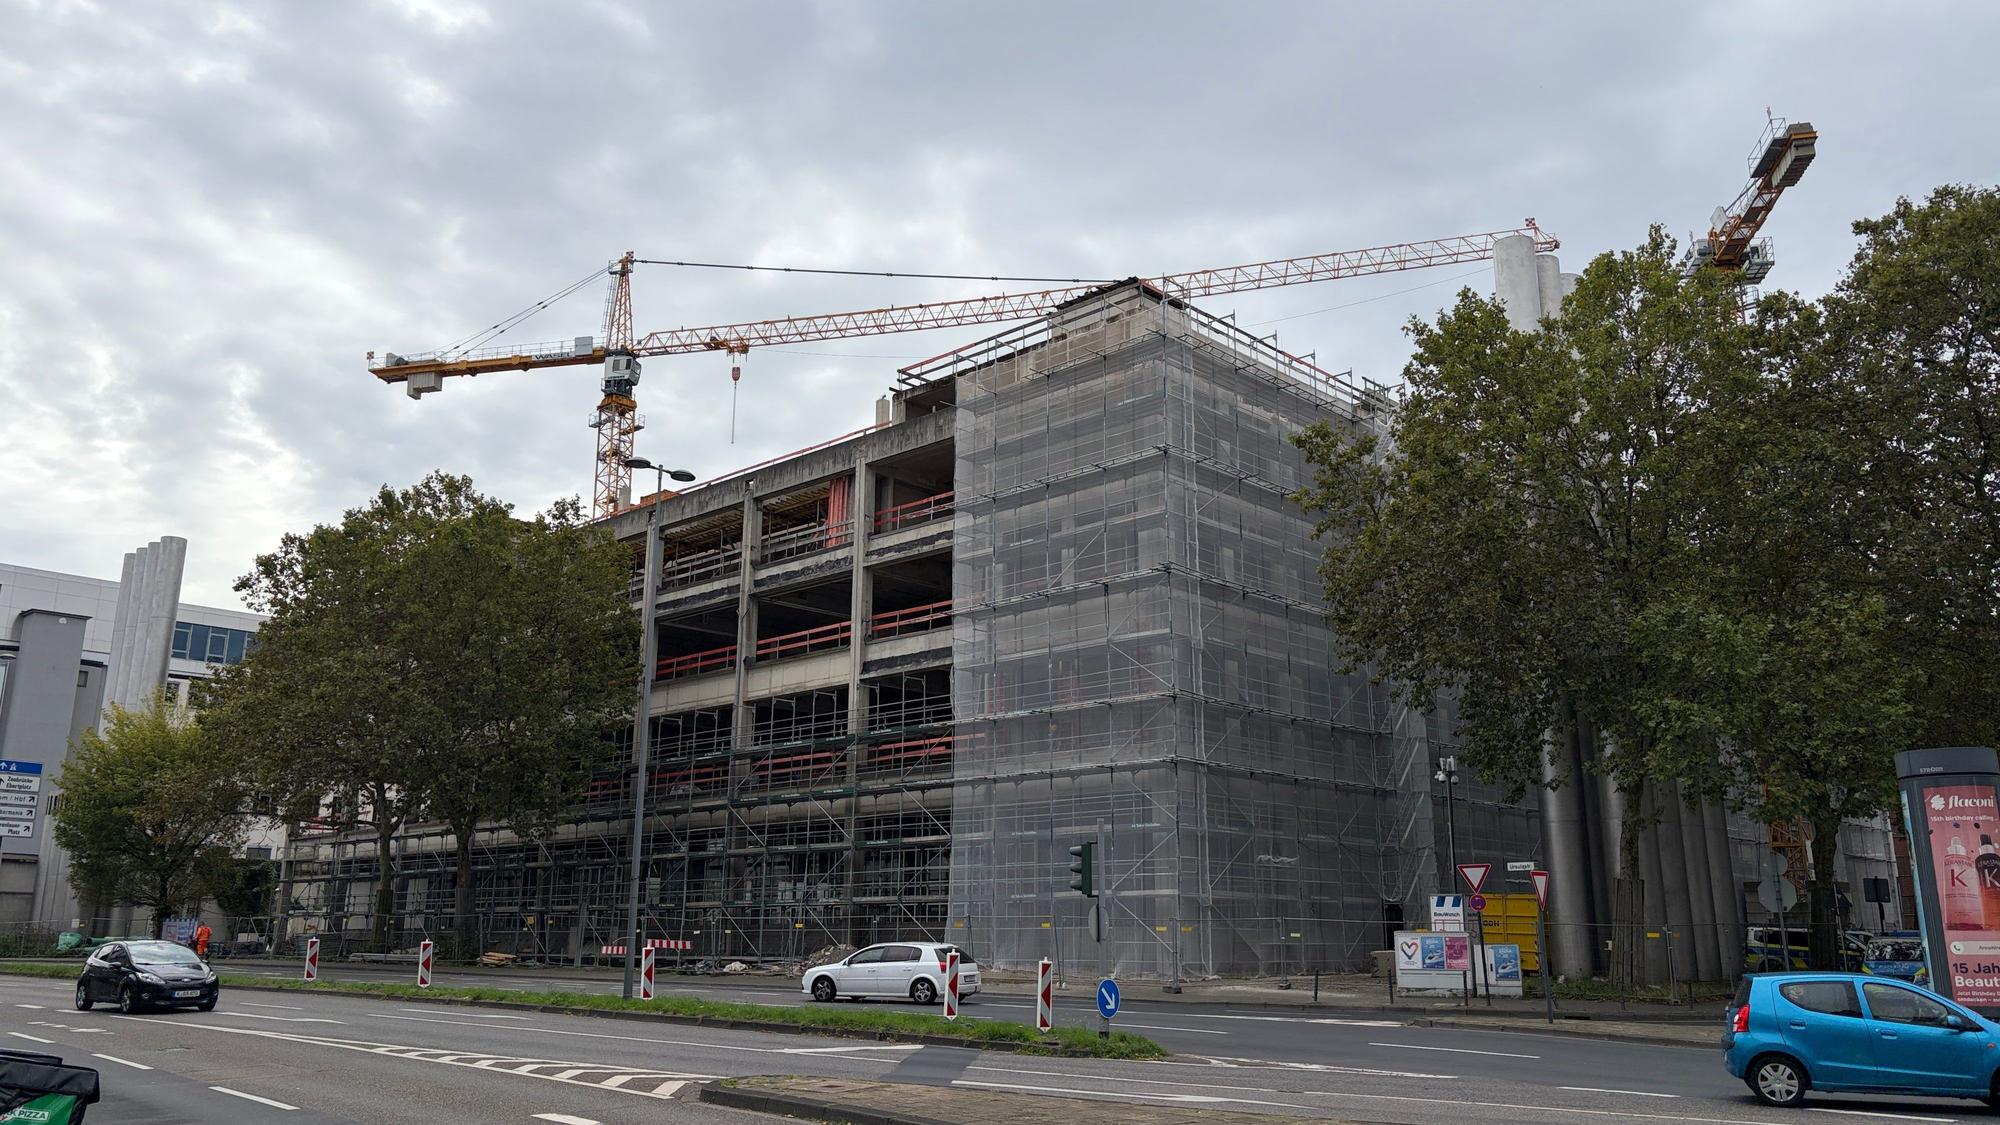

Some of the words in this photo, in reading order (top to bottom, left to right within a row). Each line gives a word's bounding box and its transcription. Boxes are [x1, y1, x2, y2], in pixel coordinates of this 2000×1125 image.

[1948, 795, 1994, 809] flaconi
[1952, 962, 1969, 974] 15
[1973, 962, 2000, 974] Jah
[1955, 976, 2000, 987] Beaut
[18, 1110, 46, 1119] PIZZA
